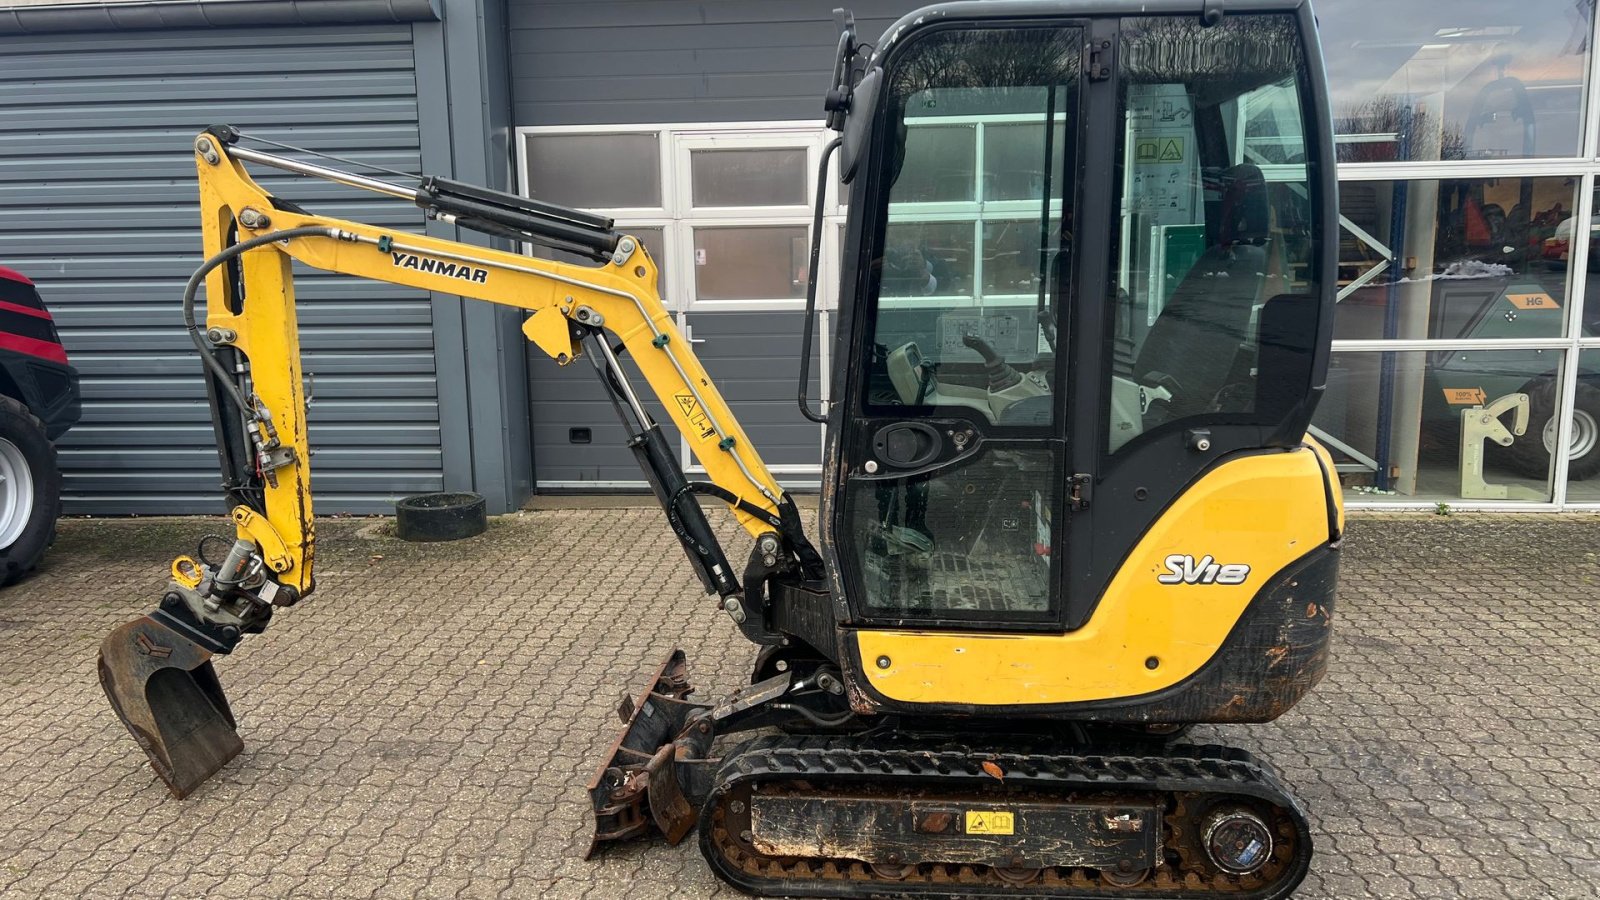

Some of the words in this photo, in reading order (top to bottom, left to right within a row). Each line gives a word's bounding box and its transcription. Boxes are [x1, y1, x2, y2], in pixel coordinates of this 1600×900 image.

[392, 251, 488, 284] YANMAR
[1526, 297, 1543, 306] HG
[1157, 554, 1251, 585] SV18
